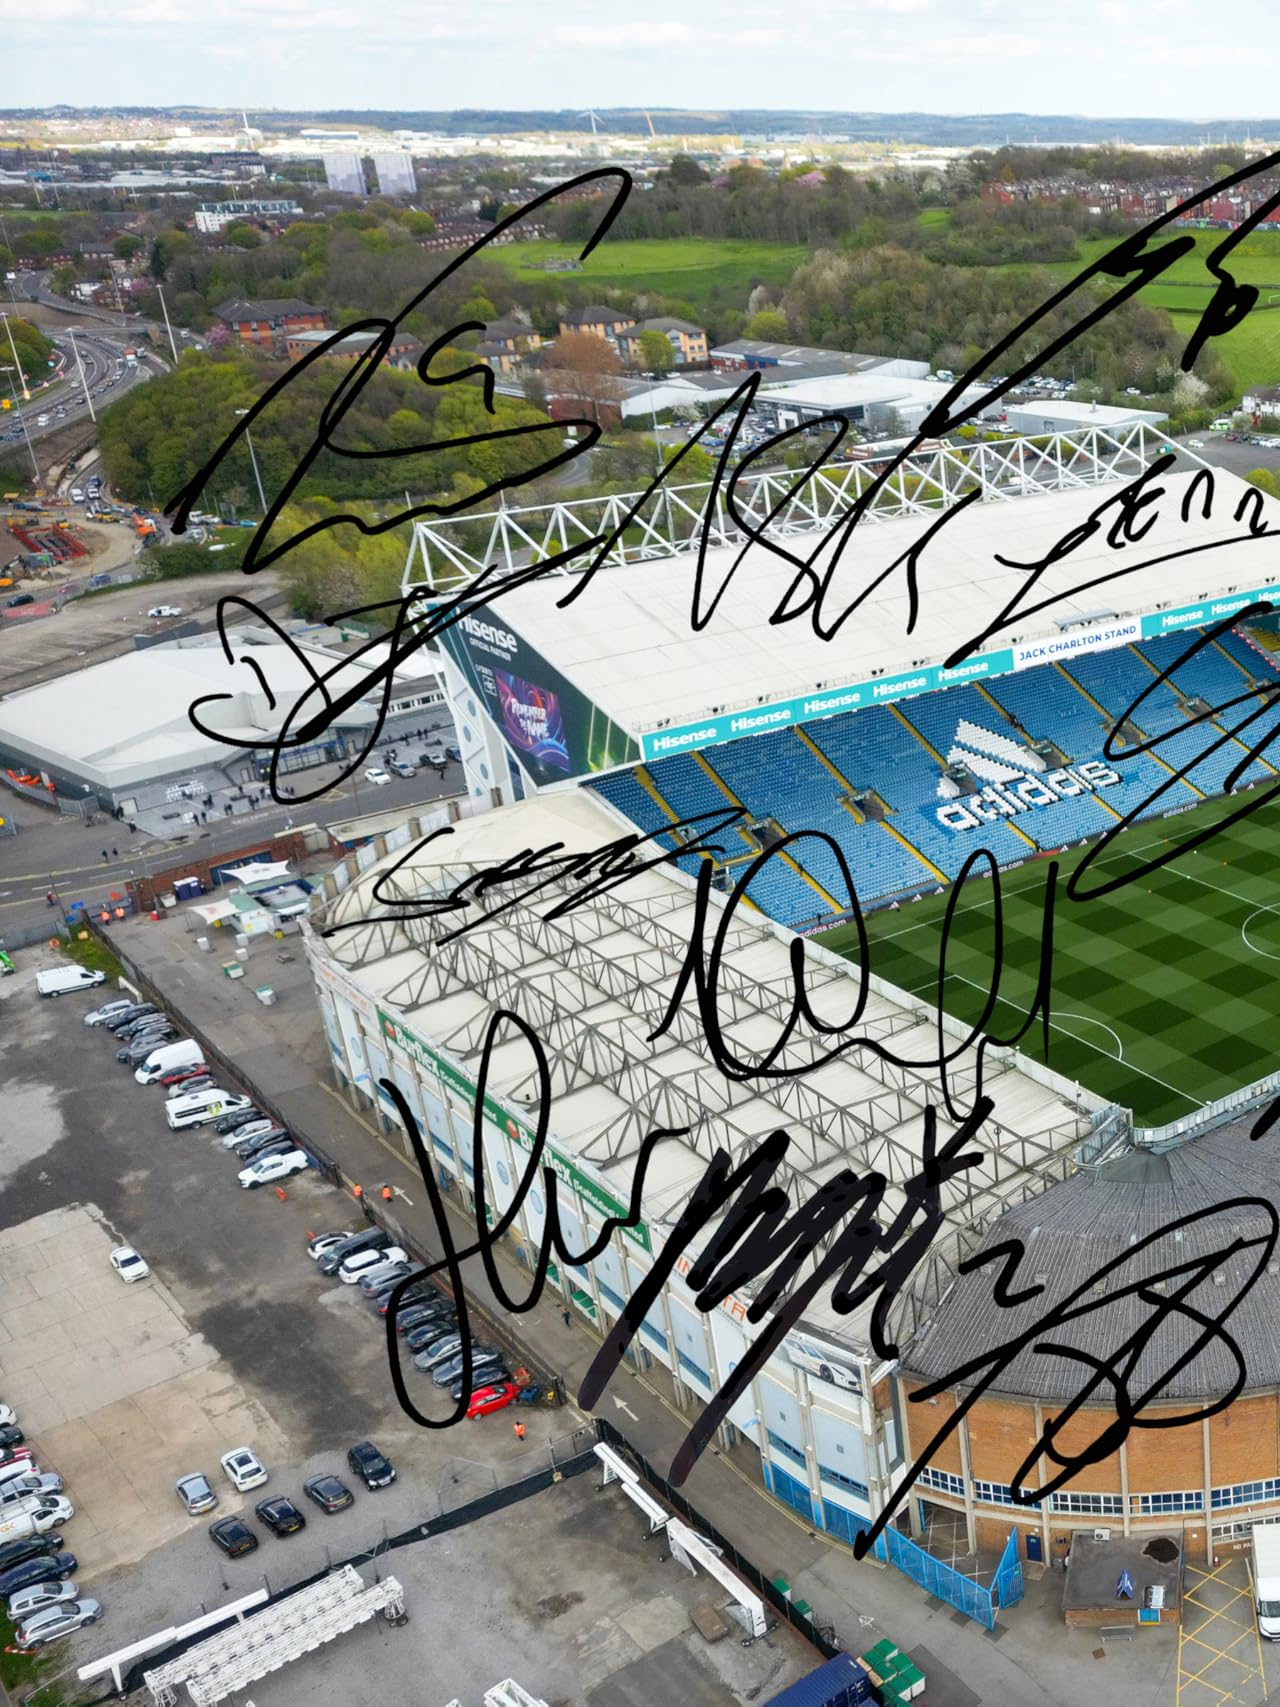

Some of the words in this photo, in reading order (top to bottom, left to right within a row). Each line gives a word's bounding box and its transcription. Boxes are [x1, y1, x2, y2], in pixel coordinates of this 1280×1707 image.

[1163, 609, 1203, 626] Hisense
[1211, 598, 1250, 615] Hisense
[1019, 645, 1046, 661] JACK
[1048, 634, 1102, 653] CHARLTON
[1104, 625, 1137, 641] STAND
[938, 661, 989, 682] Hisense
[873, 676, 927, 697] Hisense
[804, 691, 861, 714] Hisense
[731, 708, 791, 732] Hisense
[653, 727, 717, 752] Hisense
[937, 761, 1121, 831] adidas
[395, 1025, 439, 1078] Burflex
